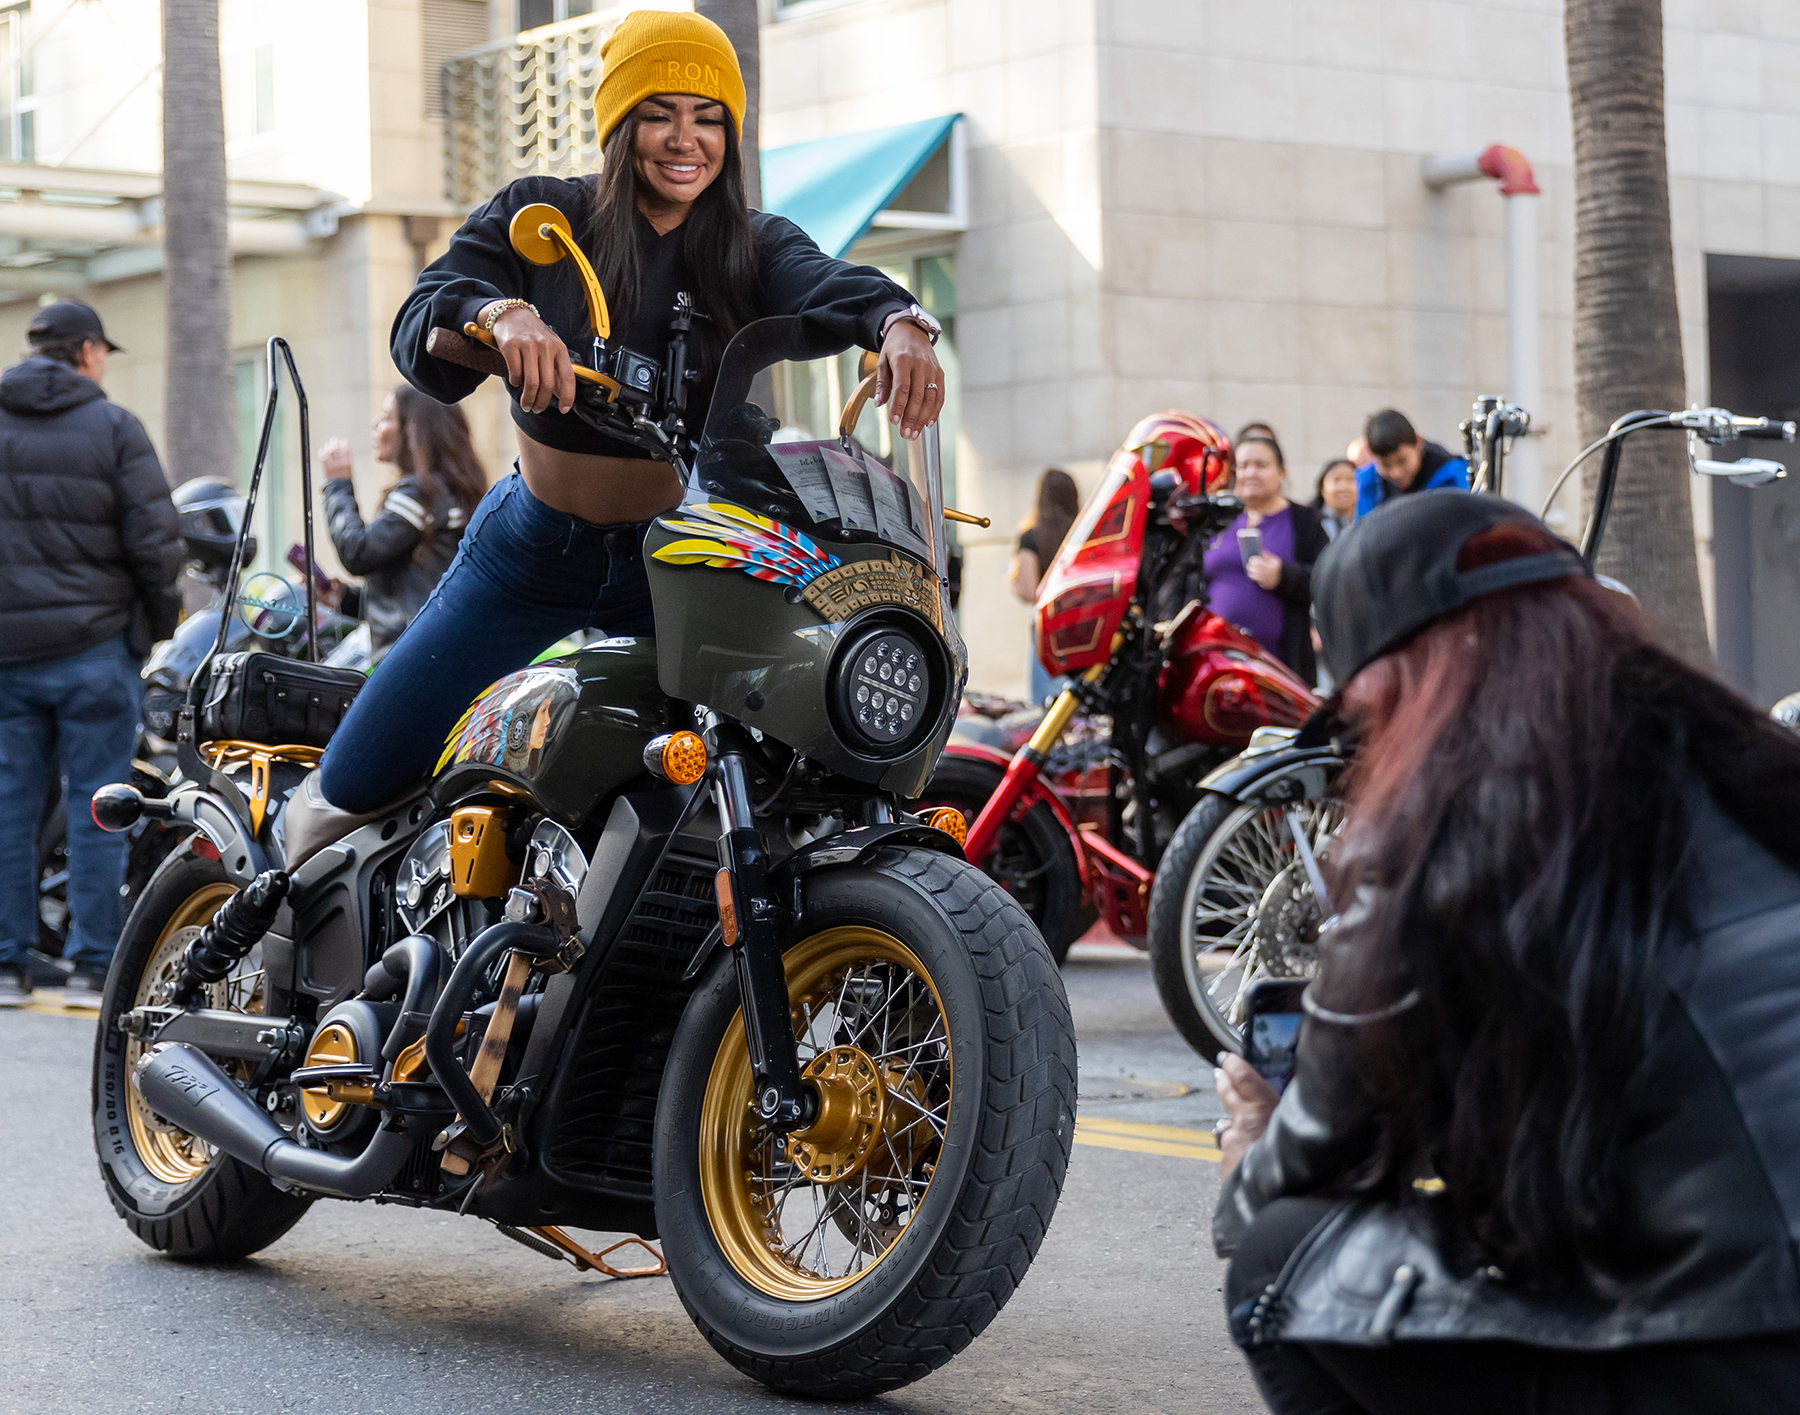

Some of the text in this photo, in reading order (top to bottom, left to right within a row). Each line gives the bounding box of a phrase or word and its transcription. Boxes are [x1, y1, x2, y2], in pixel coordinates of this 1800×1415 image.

[655, 60, 719, 86] IRON
[657, 79, 721, 98] GODDESS
[105, 1063, 117, 1121] 150/80
[109, 1125, 120, 1136] B
[112, 1140, 125, 1154] 16
[741, 1225, 921, 1331] PIRELLI MT60RS
